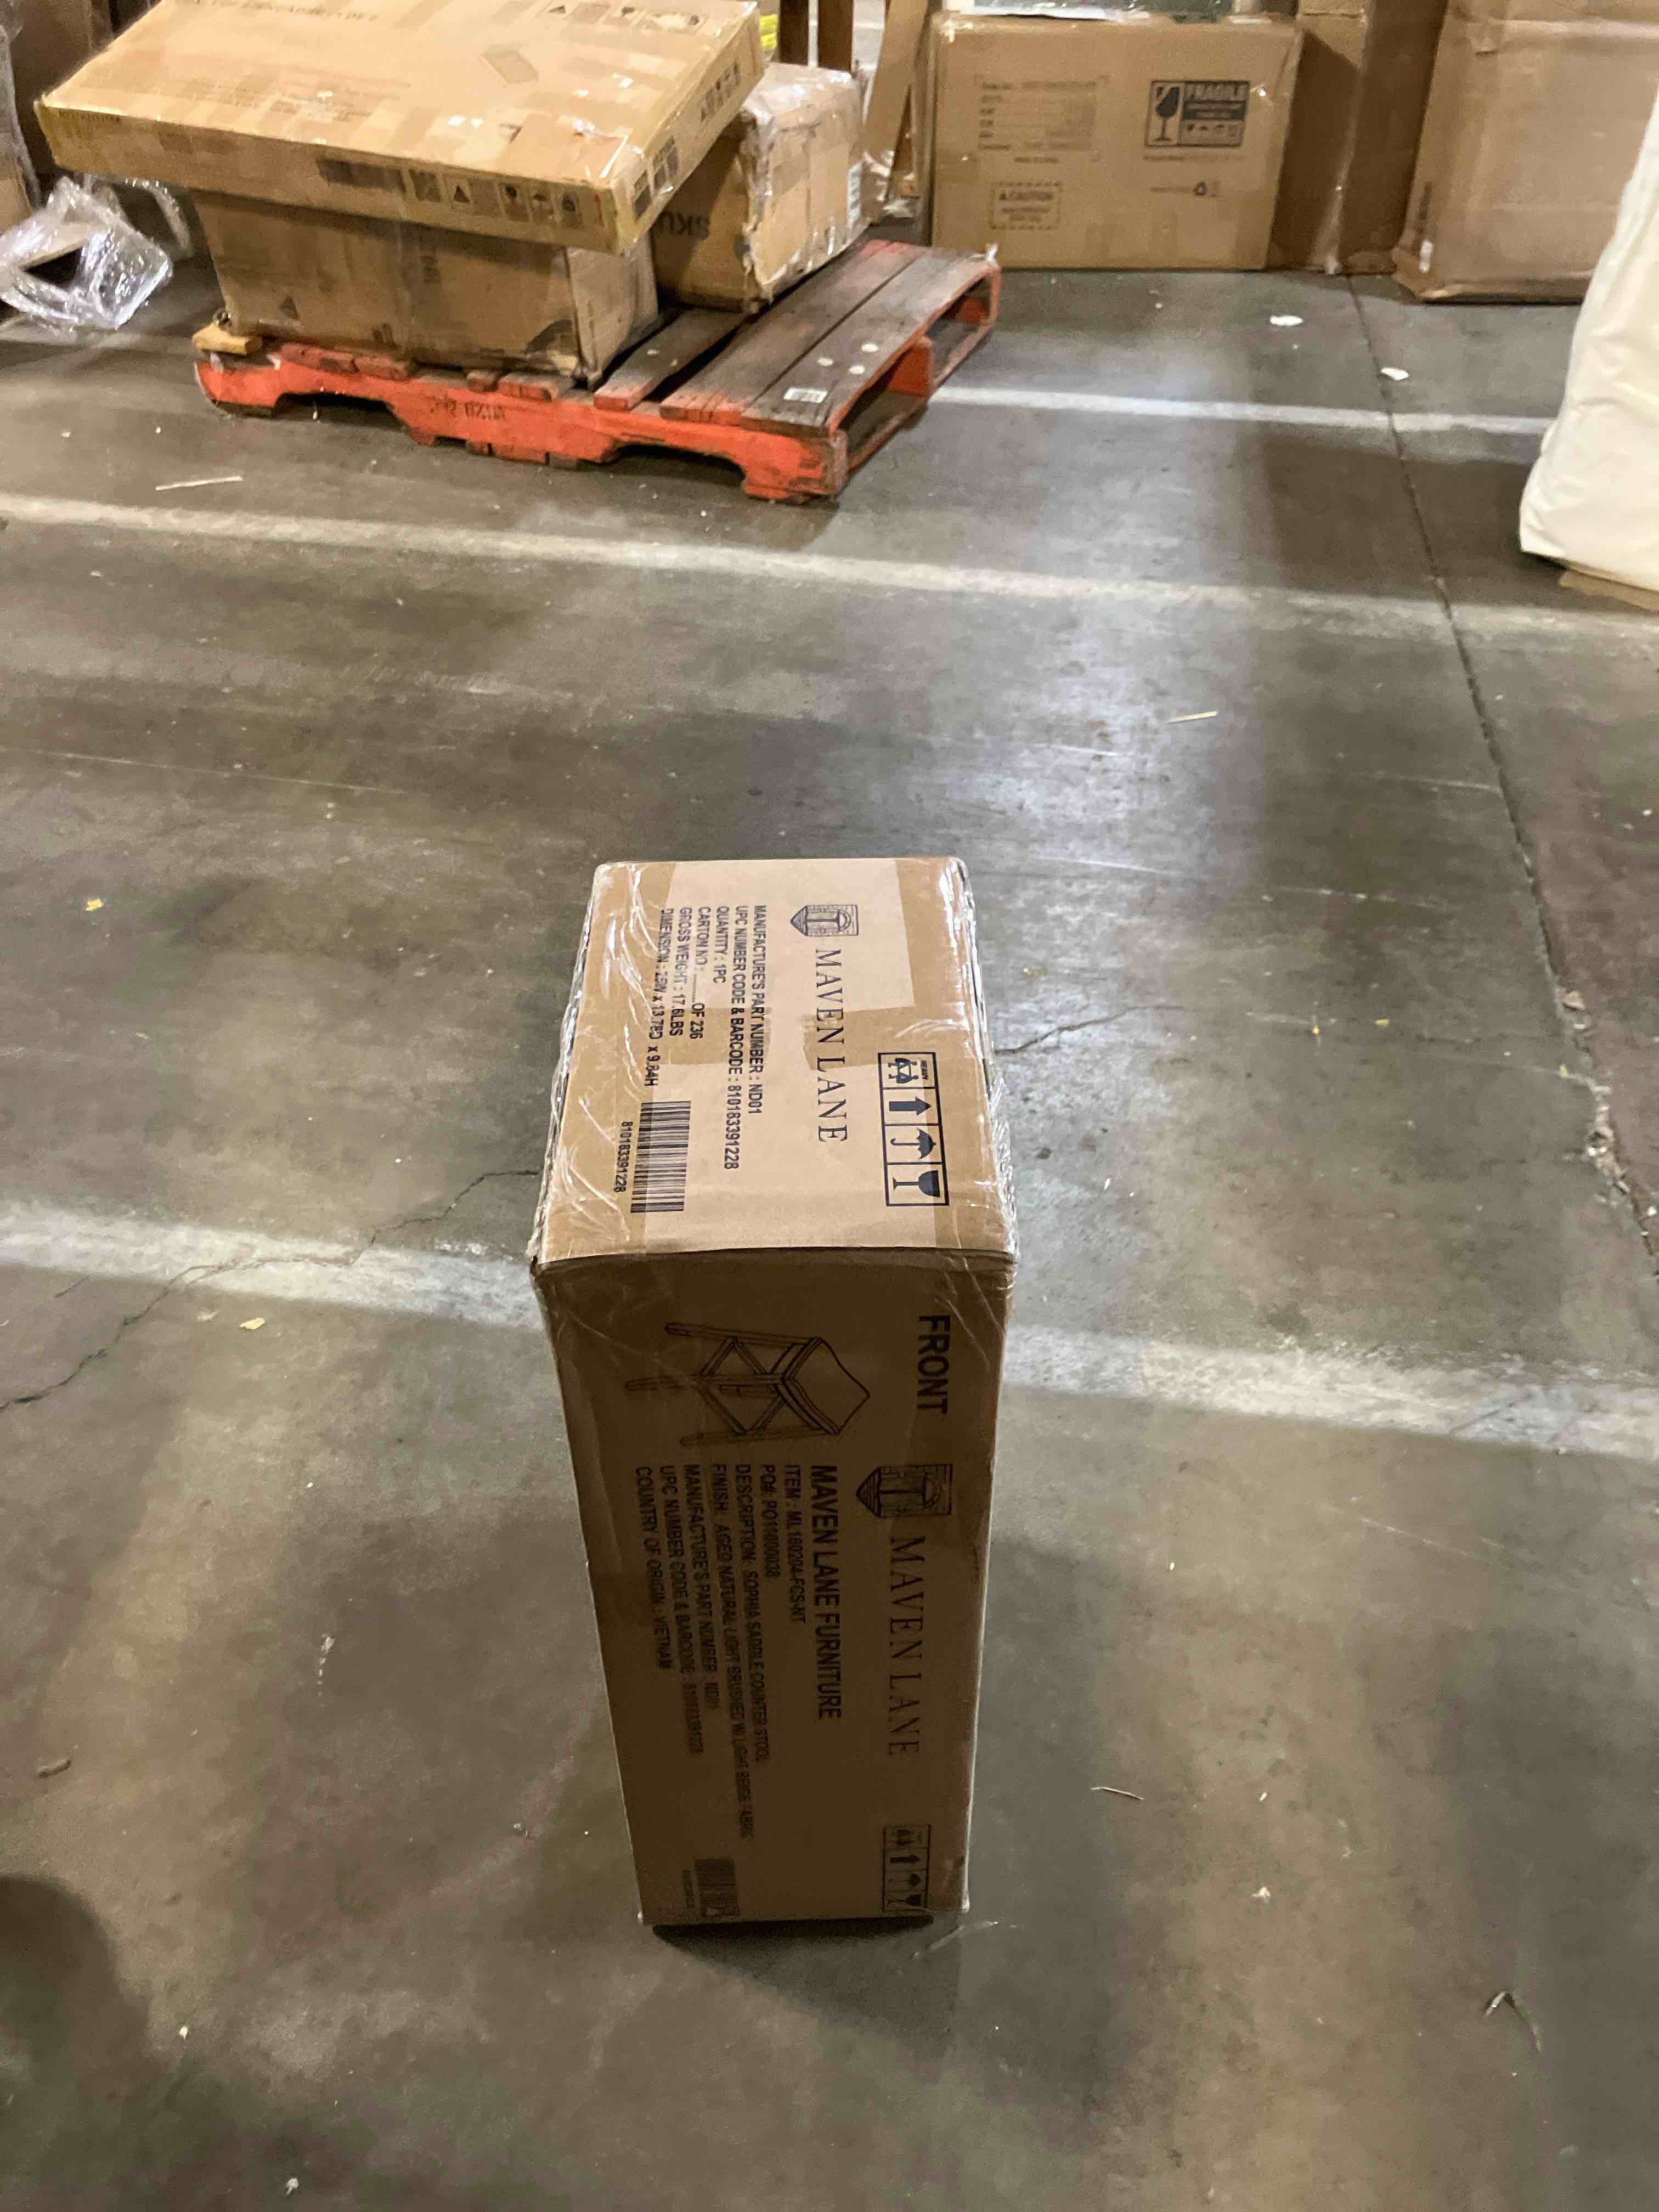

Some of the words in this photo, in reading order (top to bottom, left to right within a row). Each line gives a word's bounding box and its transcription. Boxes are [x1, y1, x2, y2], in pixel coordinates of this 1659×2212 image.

[657, 909, 673, 963] DIMENSION
[678, 907, 691, 941] GROSS
[696, 907, 710, 947] CARTON
[714, 906, 729, 955] QUANTITY
[735, 905, 748, 925] UPC
[673, 944, 689, 984] WEIGHT
[733, 928, 747, 970] NUMBER
[752, 905, 766, 990] MANUFACTURE'S
[713, 964, 726, 983] 1PC
[732, 974, 746, 1004] CODE
[816, 949, 844, 1045] MAVEN
[690, 1020, 704, 1039] 236
[751, 993, 765, 1020] PART
[728, 1018, 744, 1074] BARCODE
[749, 1024, 764, 1073] NUMBER
[748, 1084, 763, 1114] ND01
[817, 1056, 848, 1142] LANE
[724, 1086, 742, 1169] 810183391228
[613, 1122, 633, 1193] 810183391228
[917, 1316, 950, 1414] FRONT
[635, 1466, 658, 1533] COUNTRY
[659, 1465, 678, 1495] UPC
[785, 1465, 802, 1499] ITEM
[811, 1465, 838, 1544] MAVEN
[644, 1537, 660, 1555] OF
[664, 1499, 684, 1559] NUMBER
[685, 1465, 710, 1581] MANUFACTURE'S
[646, 1560, 667, 1605] ORIGIN
[669, 1562, 689, 1598] CODE
[694, 1584, 713, 1617] PART
[743, 1571, 760, 1619] SOPHIA
[814, 1550, 839, 1606] LANE
[889, 1536, 926, 1660] MAVEN
[653, 1615, 672, 1669] VIETNAM
[676, 1615, 696, 1673] BARCODE
[699, 1622, 718, 1672] NUMBER
[746, 1622, 764, 1668] SADDLE
[815, 1613, 842, 1720] FURNITURE
[750, 1673, 767, 1725] COUNTER
[888, 1673, 922, 1755] LANE
